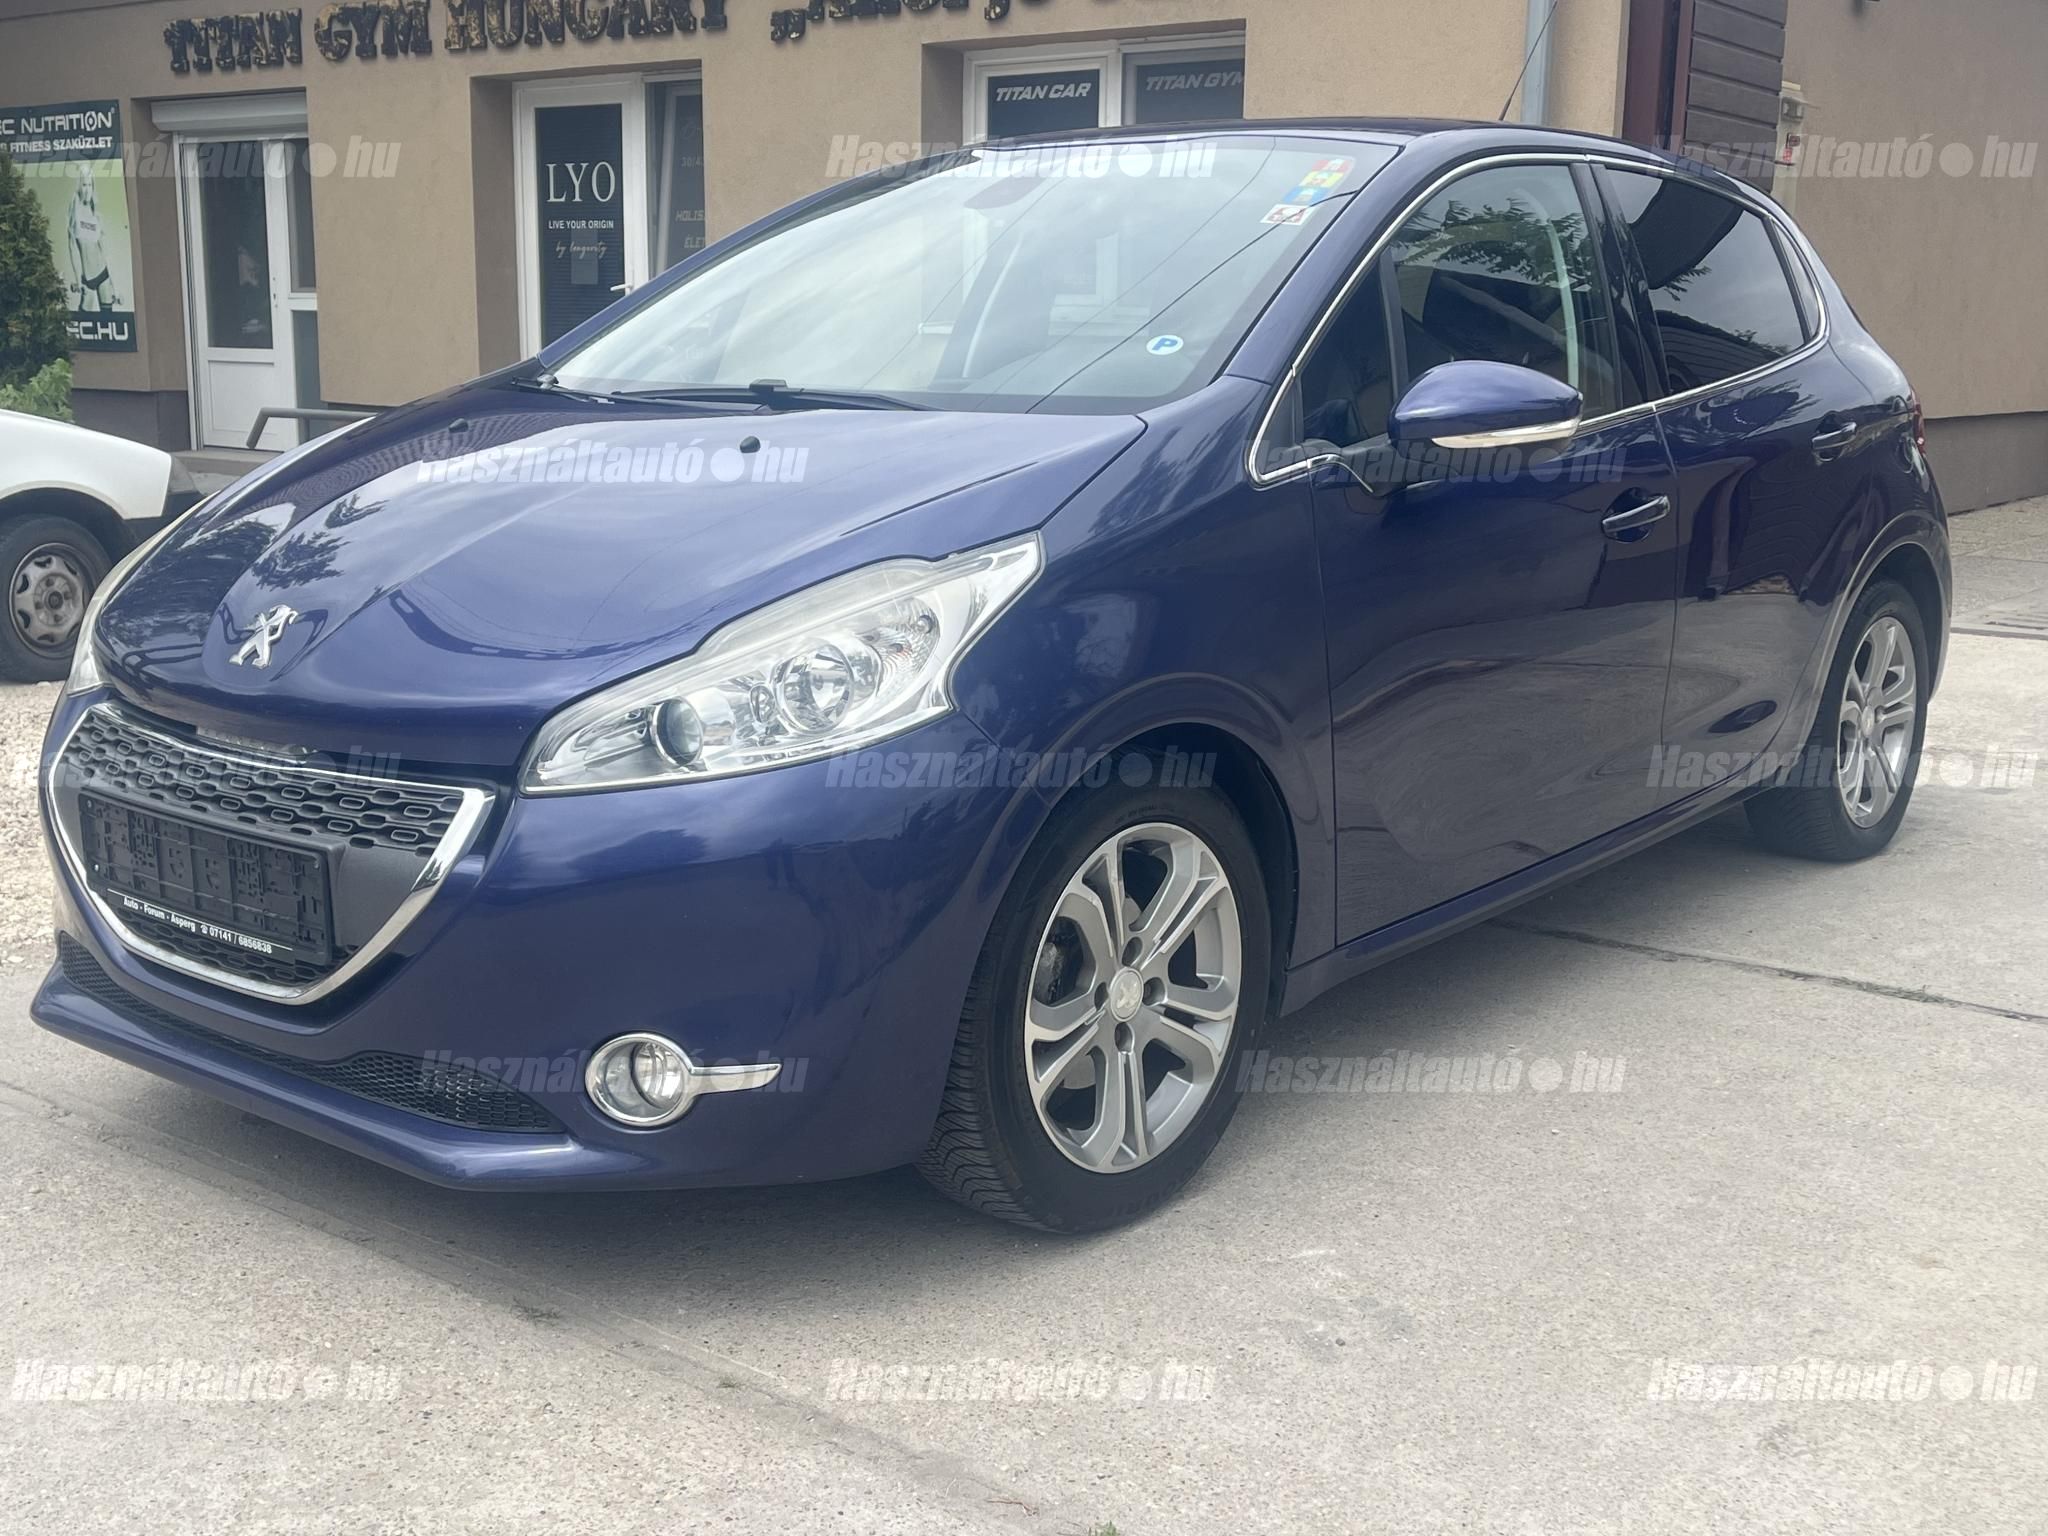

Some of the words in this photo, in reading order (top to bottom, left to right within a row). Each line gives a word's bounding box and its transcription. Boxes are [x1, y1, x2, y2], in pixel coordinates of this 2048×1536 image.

[164, 8, 302, 73] TITAN
[314, 0, 432, 61] GYM
[1146, 73, 1204, 90] TITAN
[996, 85, 1049, 101] TITAN
[1049, 82, 1092, 98] CAR
[21, 111, 112, 134] NUTRITION
[10, 140, 51, 152] FITNESS
[53, 135, 112, 151] SZAKÜZLET
[546, 161, 616, 203] LYO
[548, 220, 565, 229] LIVE
[566, 220, 587, 229] YOUR
[588, 220, 614, 229] ORIGIN
[1151, 337, 1179, 351] P
[123, 896, 139, 910] Auto
[143, 904, 165, 920] Forum
[171, 913, 196, 932] Asperg
[209, 927, 231, 942] 07141
